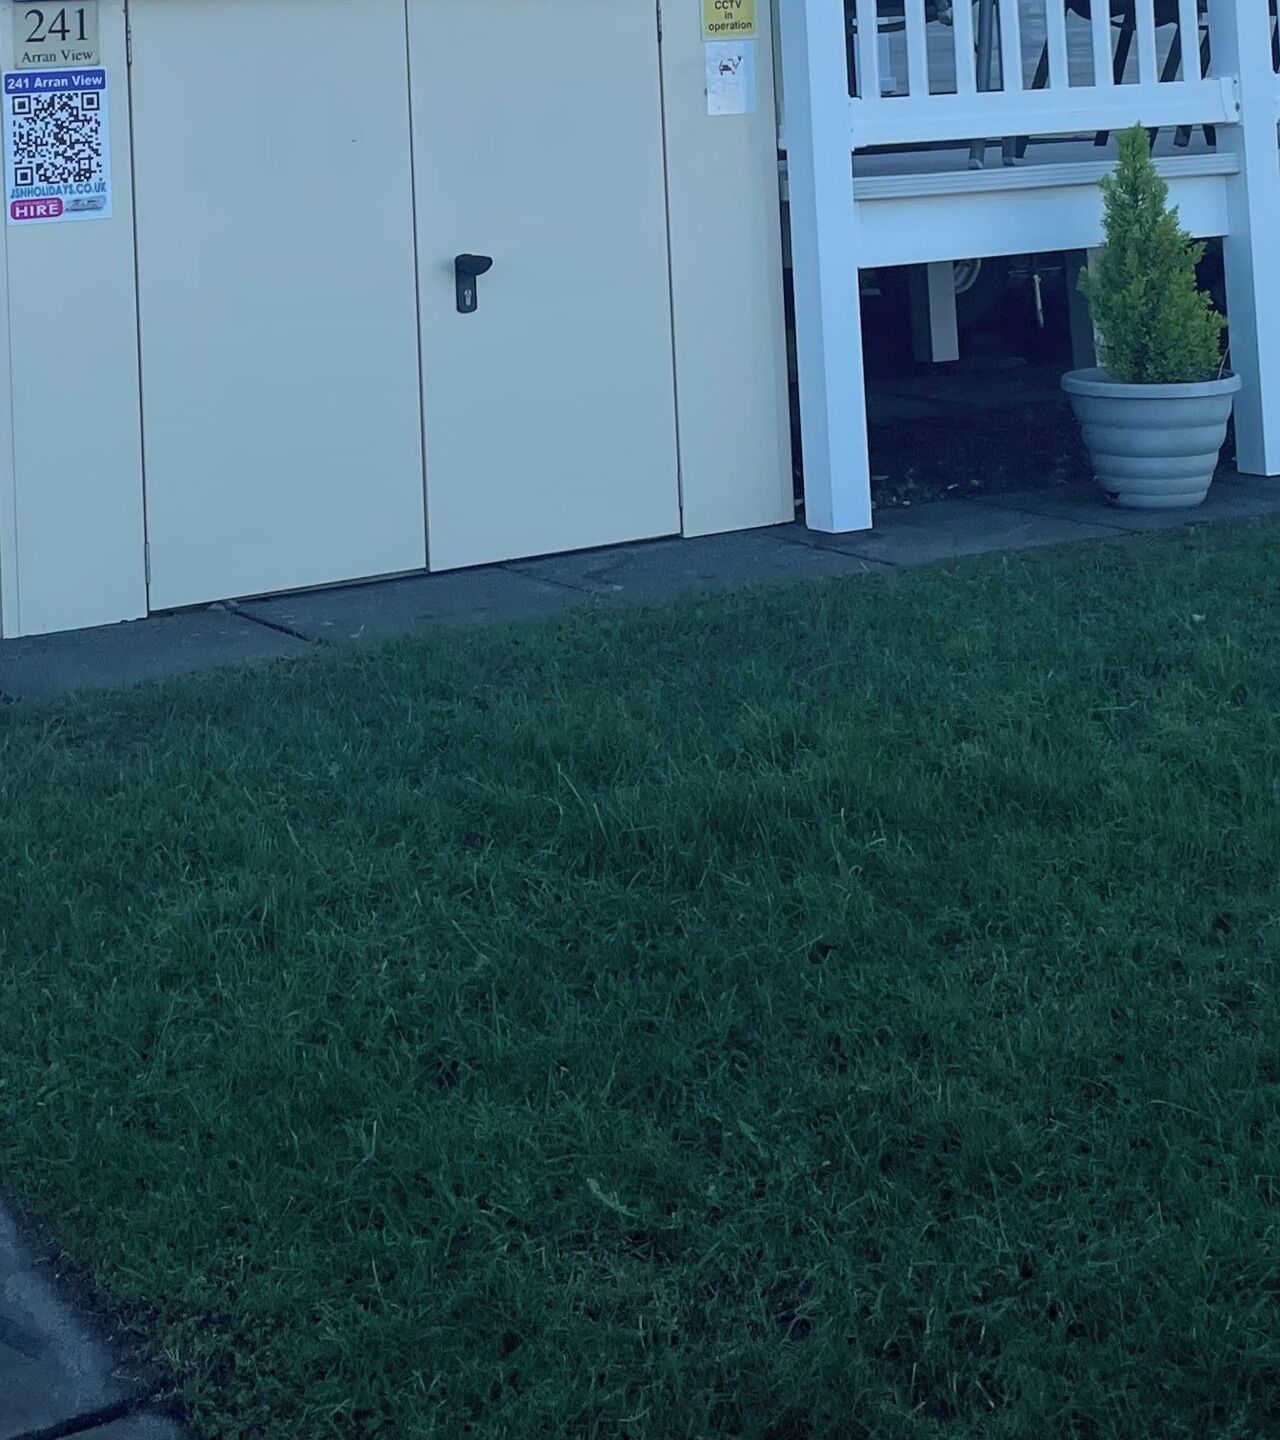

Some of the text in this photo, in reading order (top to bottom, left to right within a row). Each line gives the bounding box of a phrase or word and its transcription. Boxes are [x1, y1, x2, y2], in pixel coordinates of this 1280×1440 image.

[714, 0, 742, 10] CCTV
[724, 10, 733, 20] in
[24, 7, 89, 44] 241
[708, 21, 753, 32] operation
[21, 49, 94, 64] Arran View
[7, 74, 103, 90] 241 Arran View
[10, 182, 107, 199] JSNHOLIDAYS.CO.UK
[15, 203, 59, 218] HIRE
